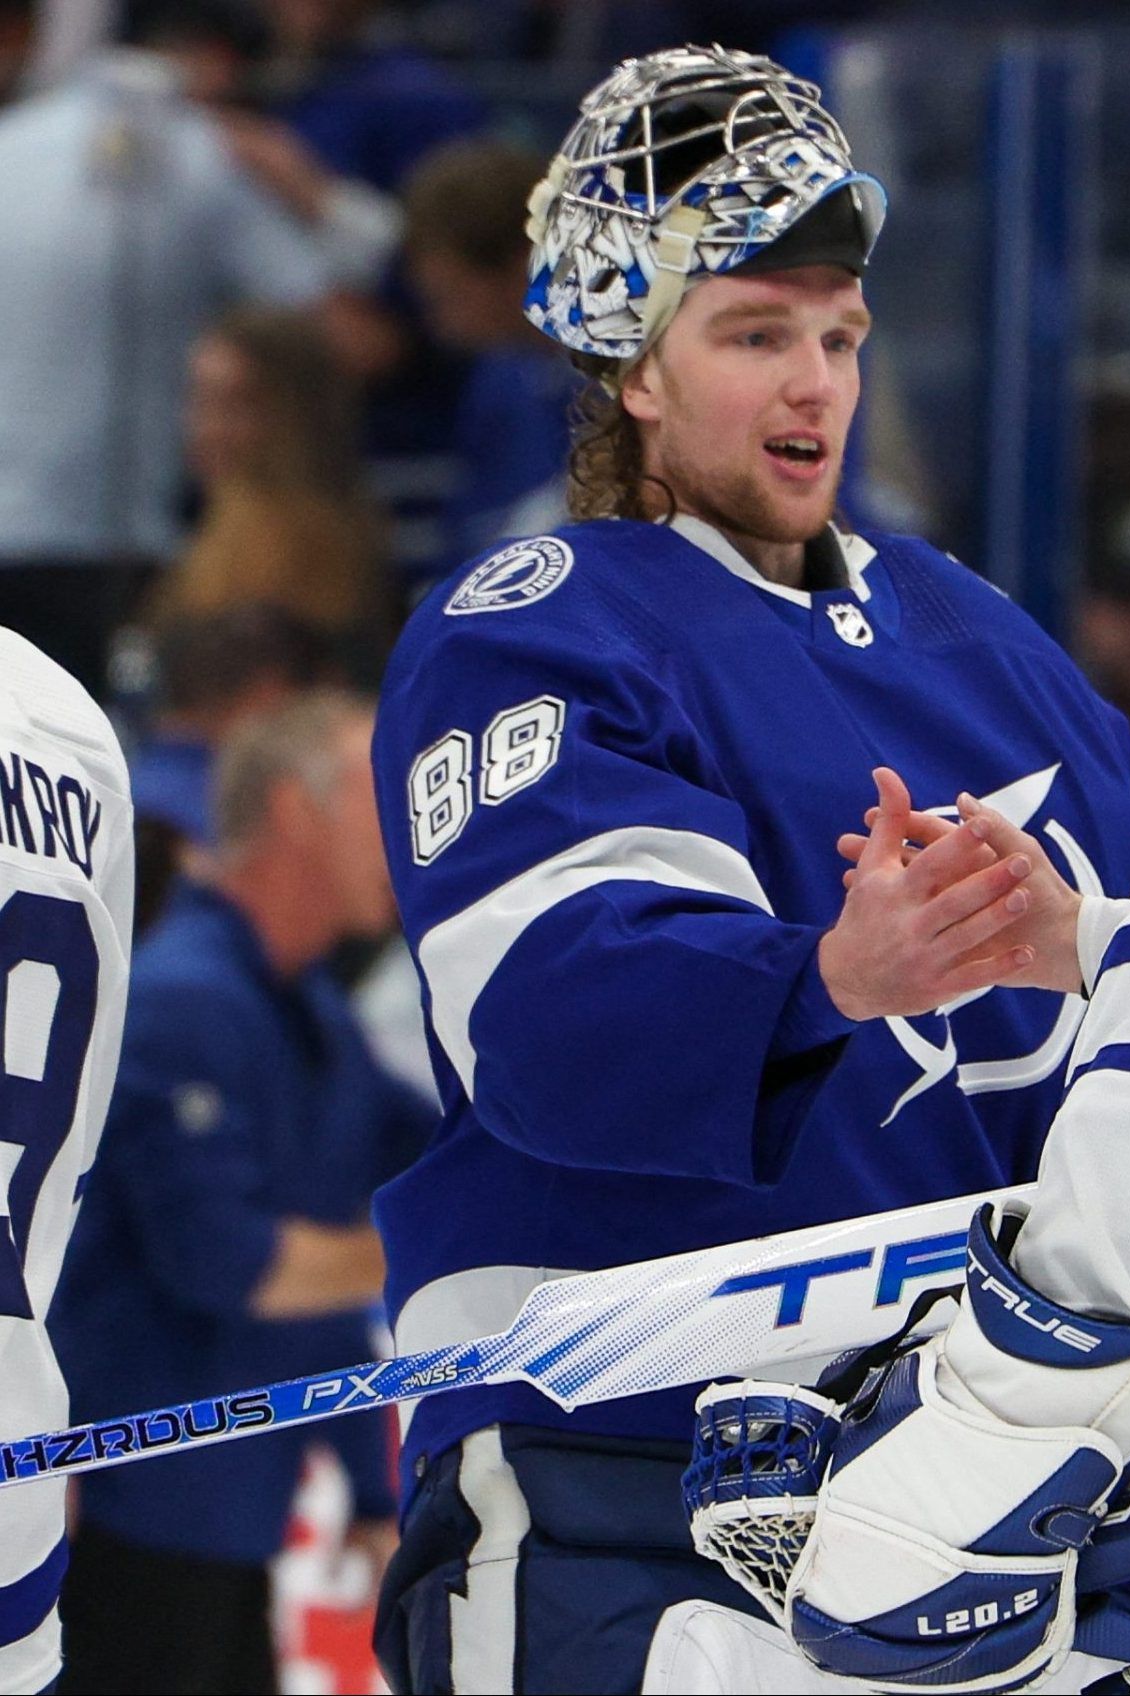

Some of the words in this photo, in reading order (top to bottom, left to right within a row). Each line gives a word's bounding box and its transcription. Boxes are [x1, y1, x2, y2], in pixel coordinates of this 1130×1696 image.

[408, 695, 567, 867] 88
[967, 1247, 1101, 1352] TRUE
[2, 1392, 274, 1478] HZRDUS
[302, 1362, 393, 1412] PX
[916, 1588, 1040, 1636] L20.2
